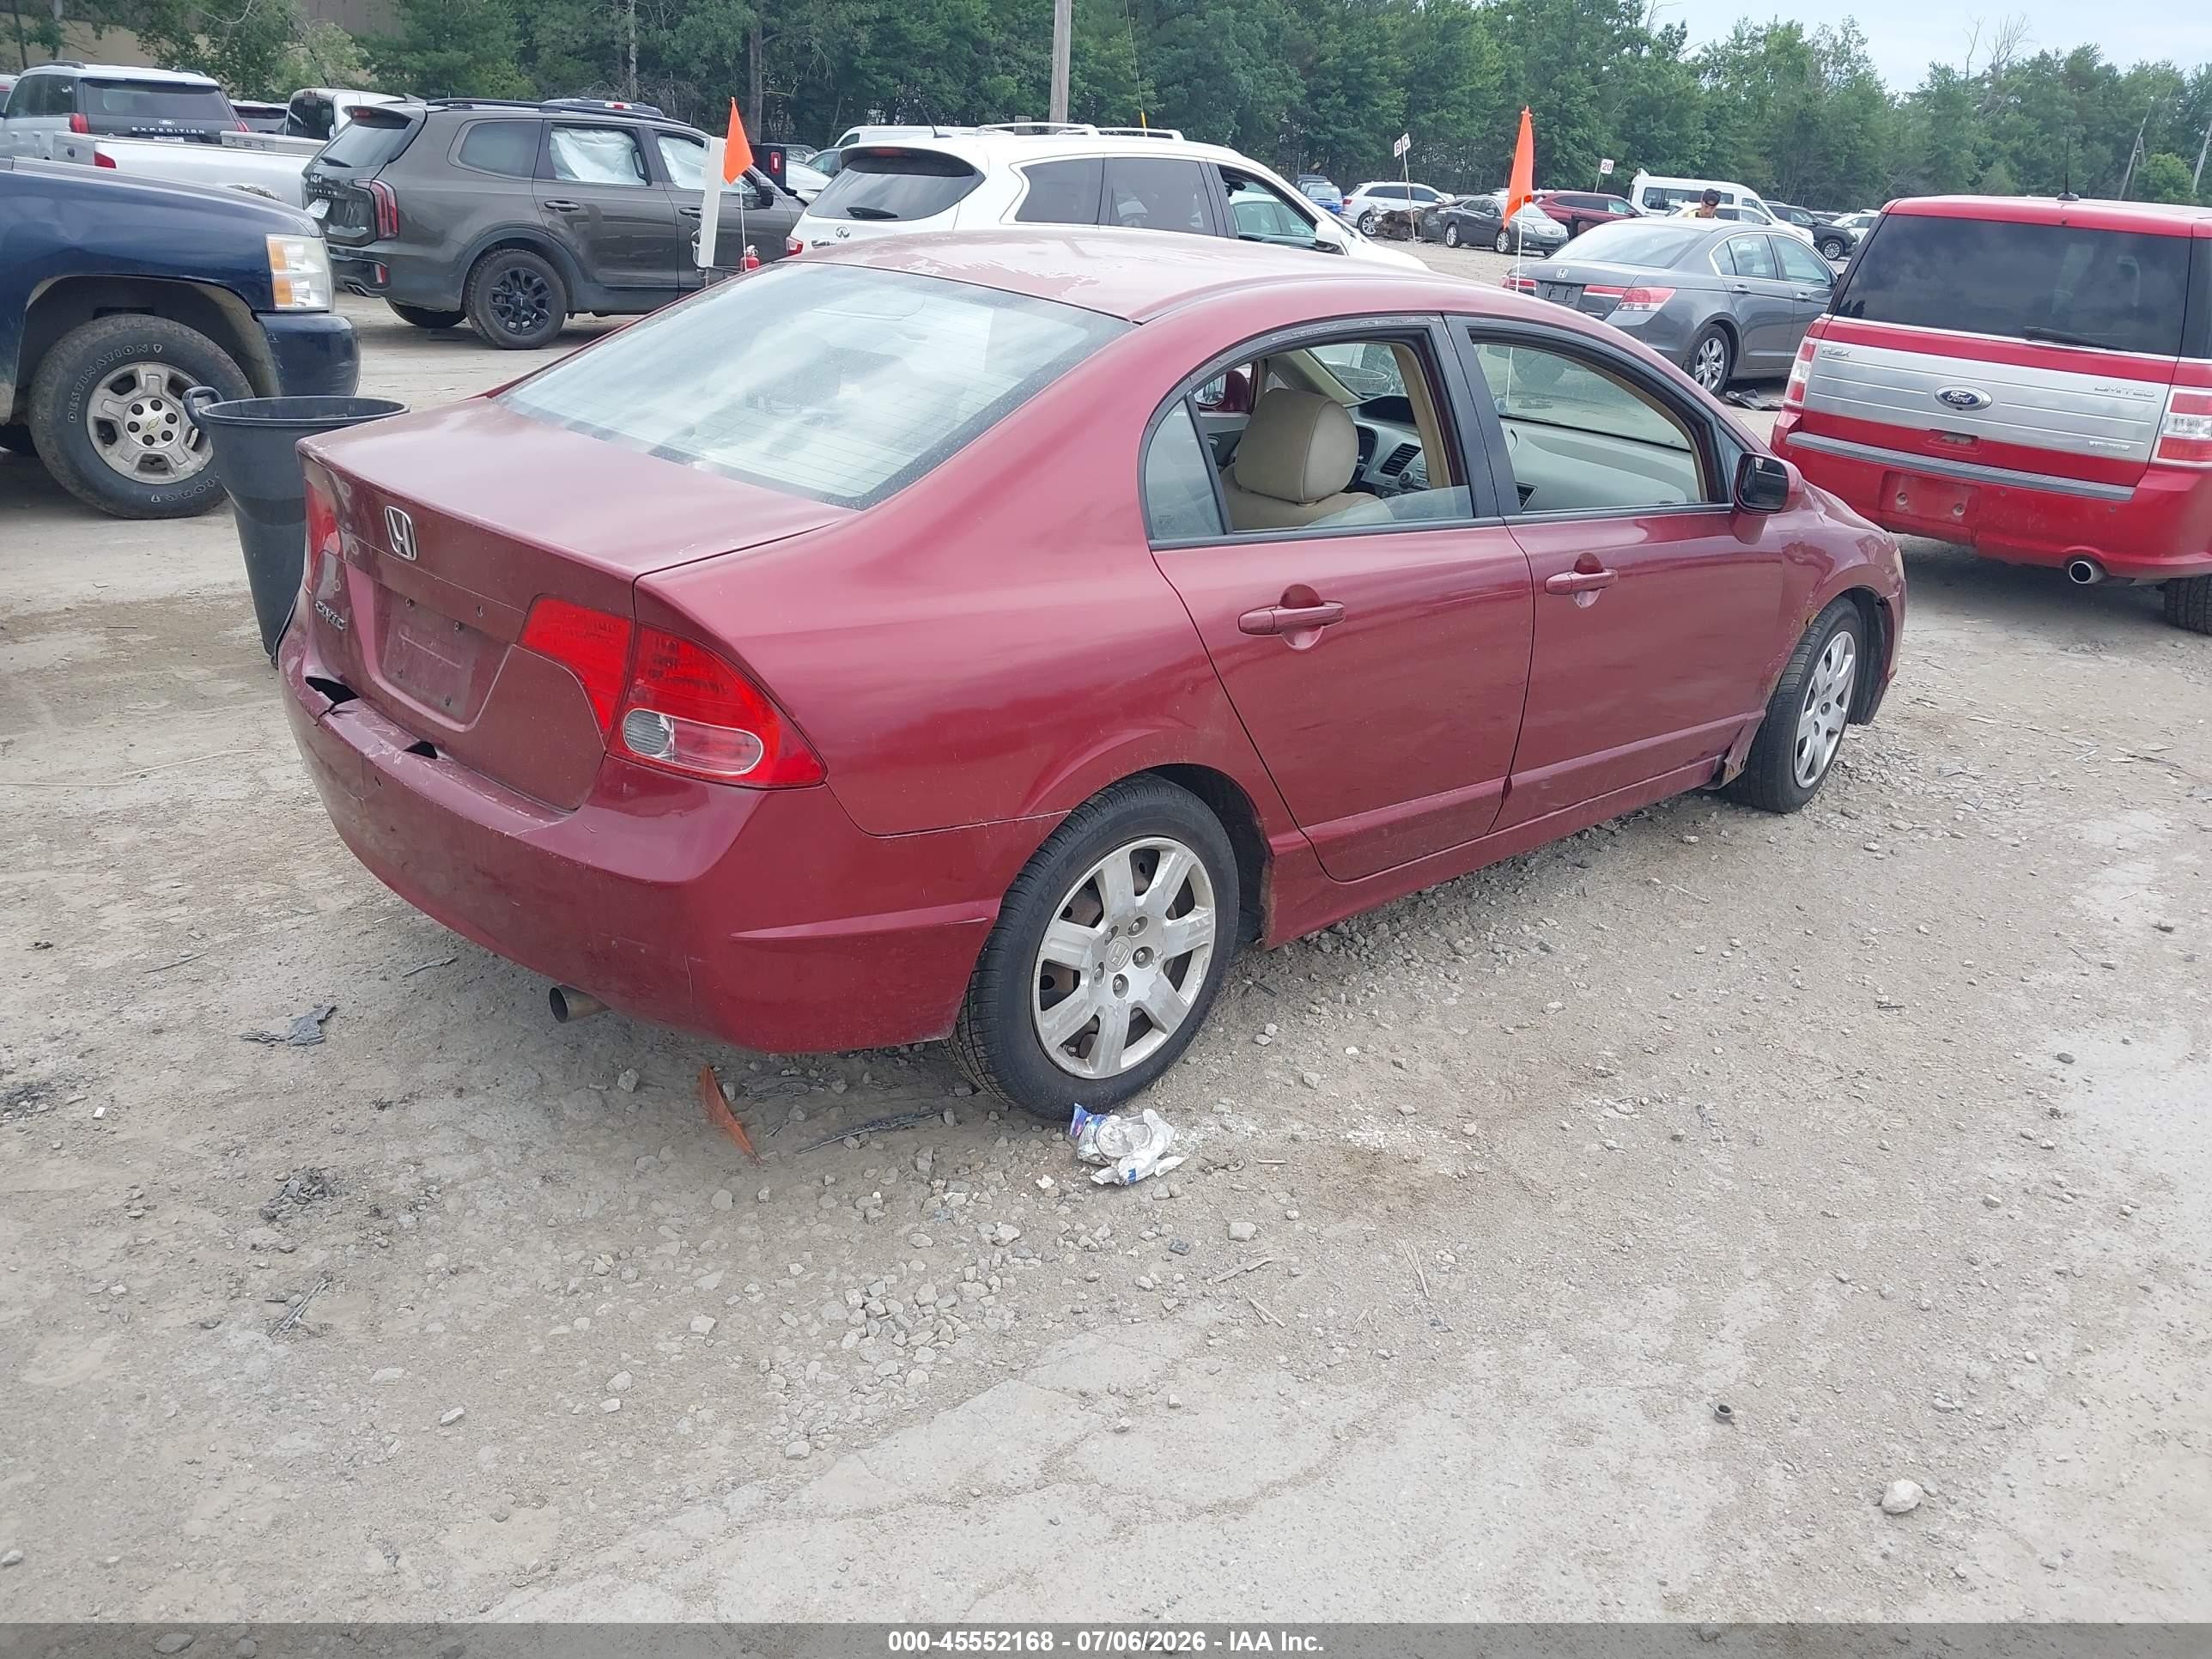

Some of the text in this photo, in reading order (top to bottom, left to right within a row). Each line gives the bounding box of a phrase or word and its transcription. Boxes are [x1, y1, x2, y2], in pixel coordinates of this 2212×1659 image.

[1601, 162, 1613, 172] 20
[1822, 347, 1852, 357] FLEX
[68, 343, 149, 423] DESTINATION
[1947, 391, 1973, 404] Ford
[2094, 385, 2155, 398] LIMITED
